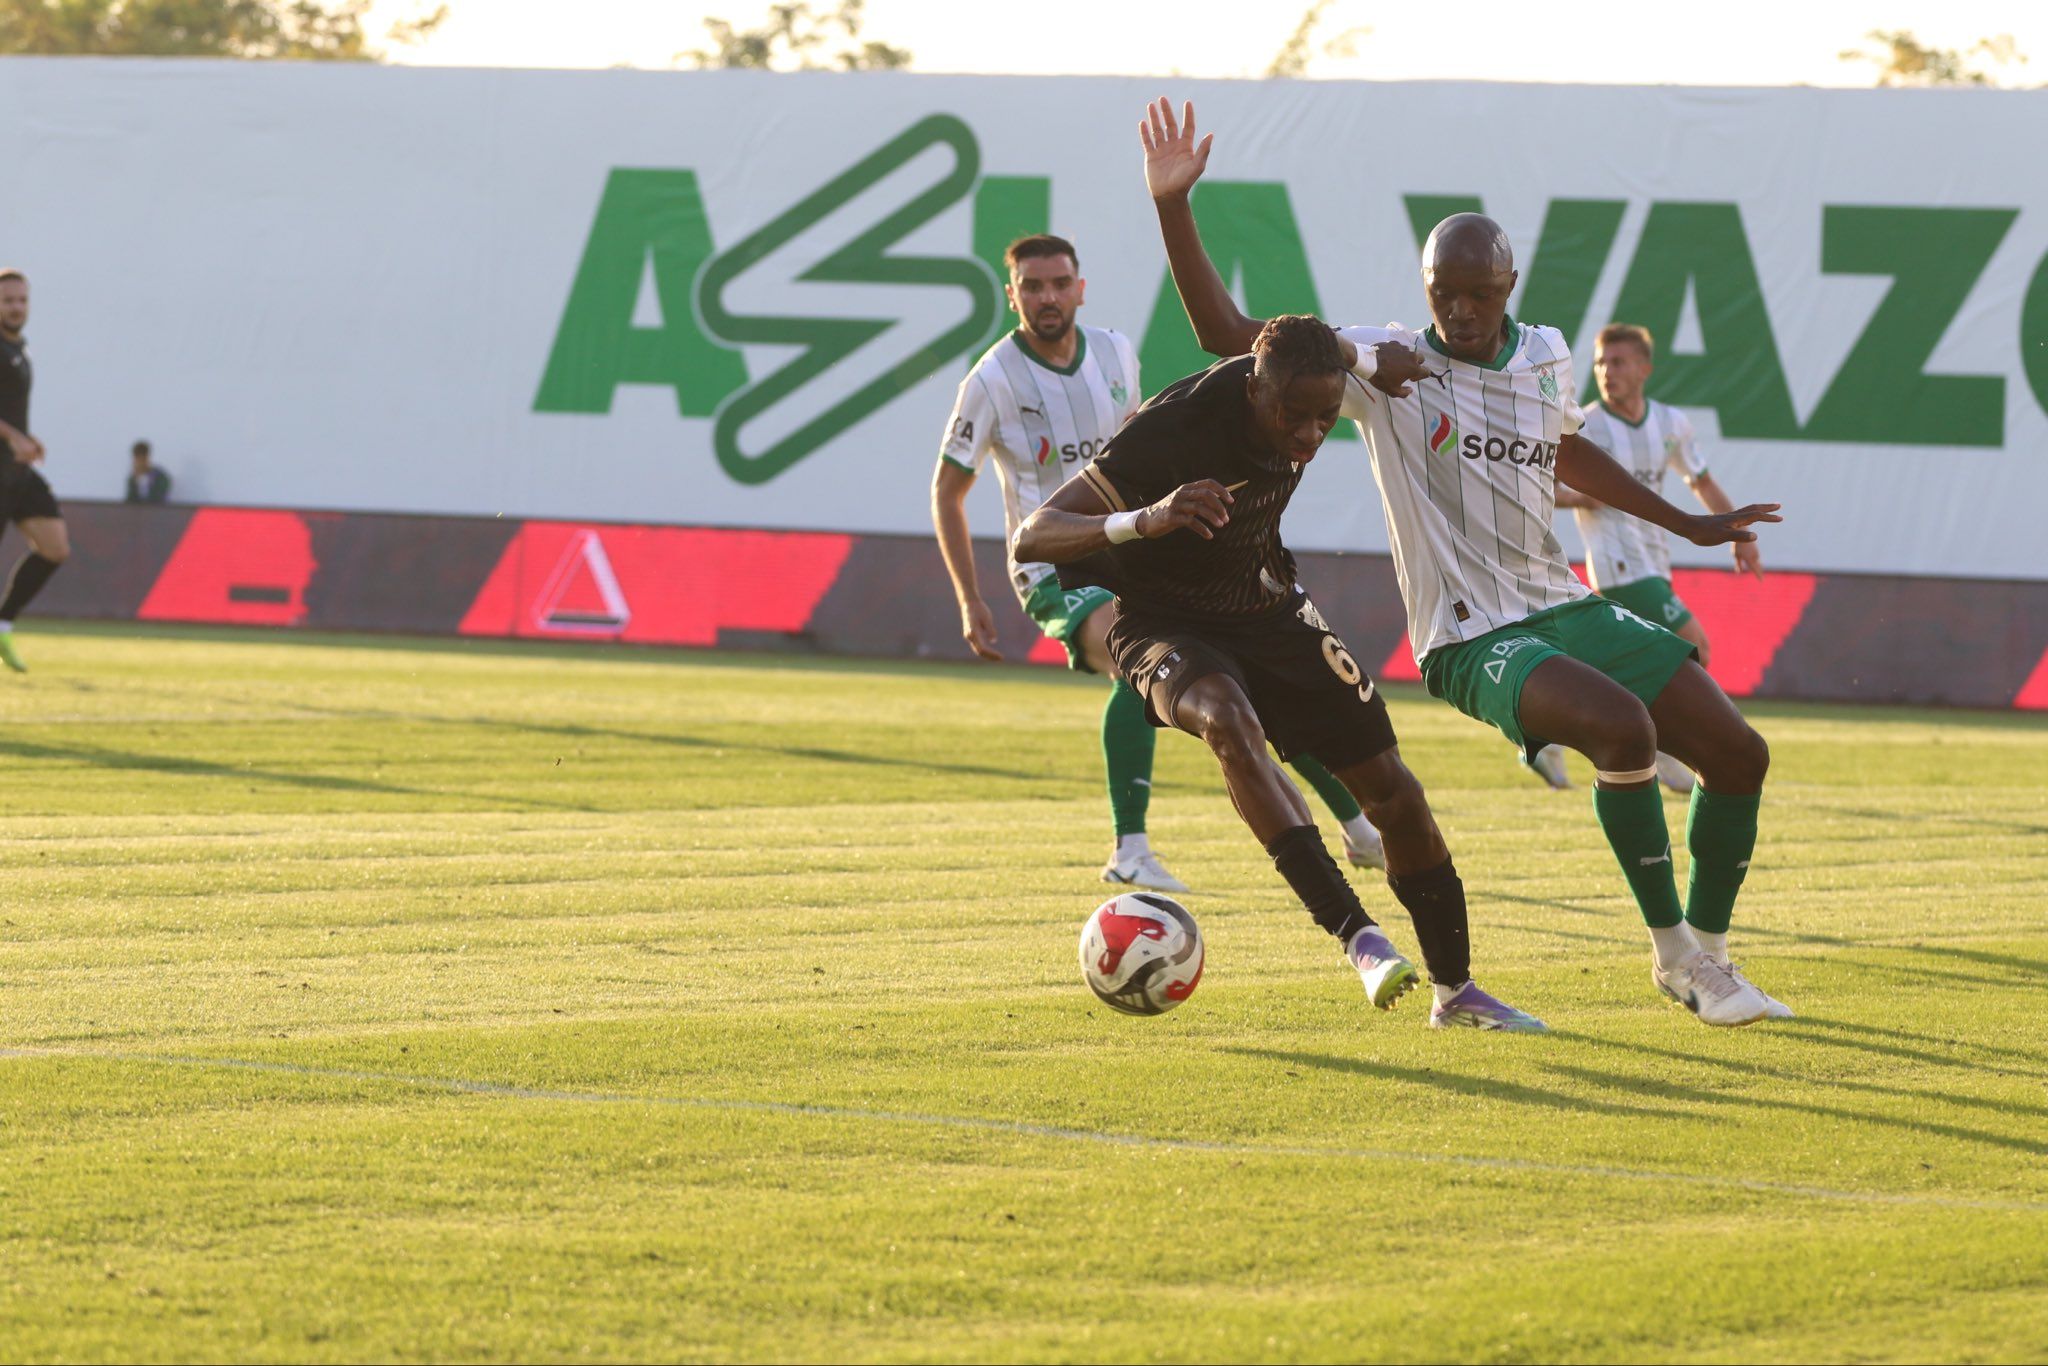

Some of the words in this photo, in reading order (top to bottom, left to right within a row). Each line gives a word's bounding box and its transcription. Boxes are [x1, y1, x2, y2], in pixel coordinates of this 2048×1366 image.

[1402, 194, 2048, 447] VAZ
[1061, 437, 1113, 463] SOC
[1462, 434, 1556, 469] SOCAR
